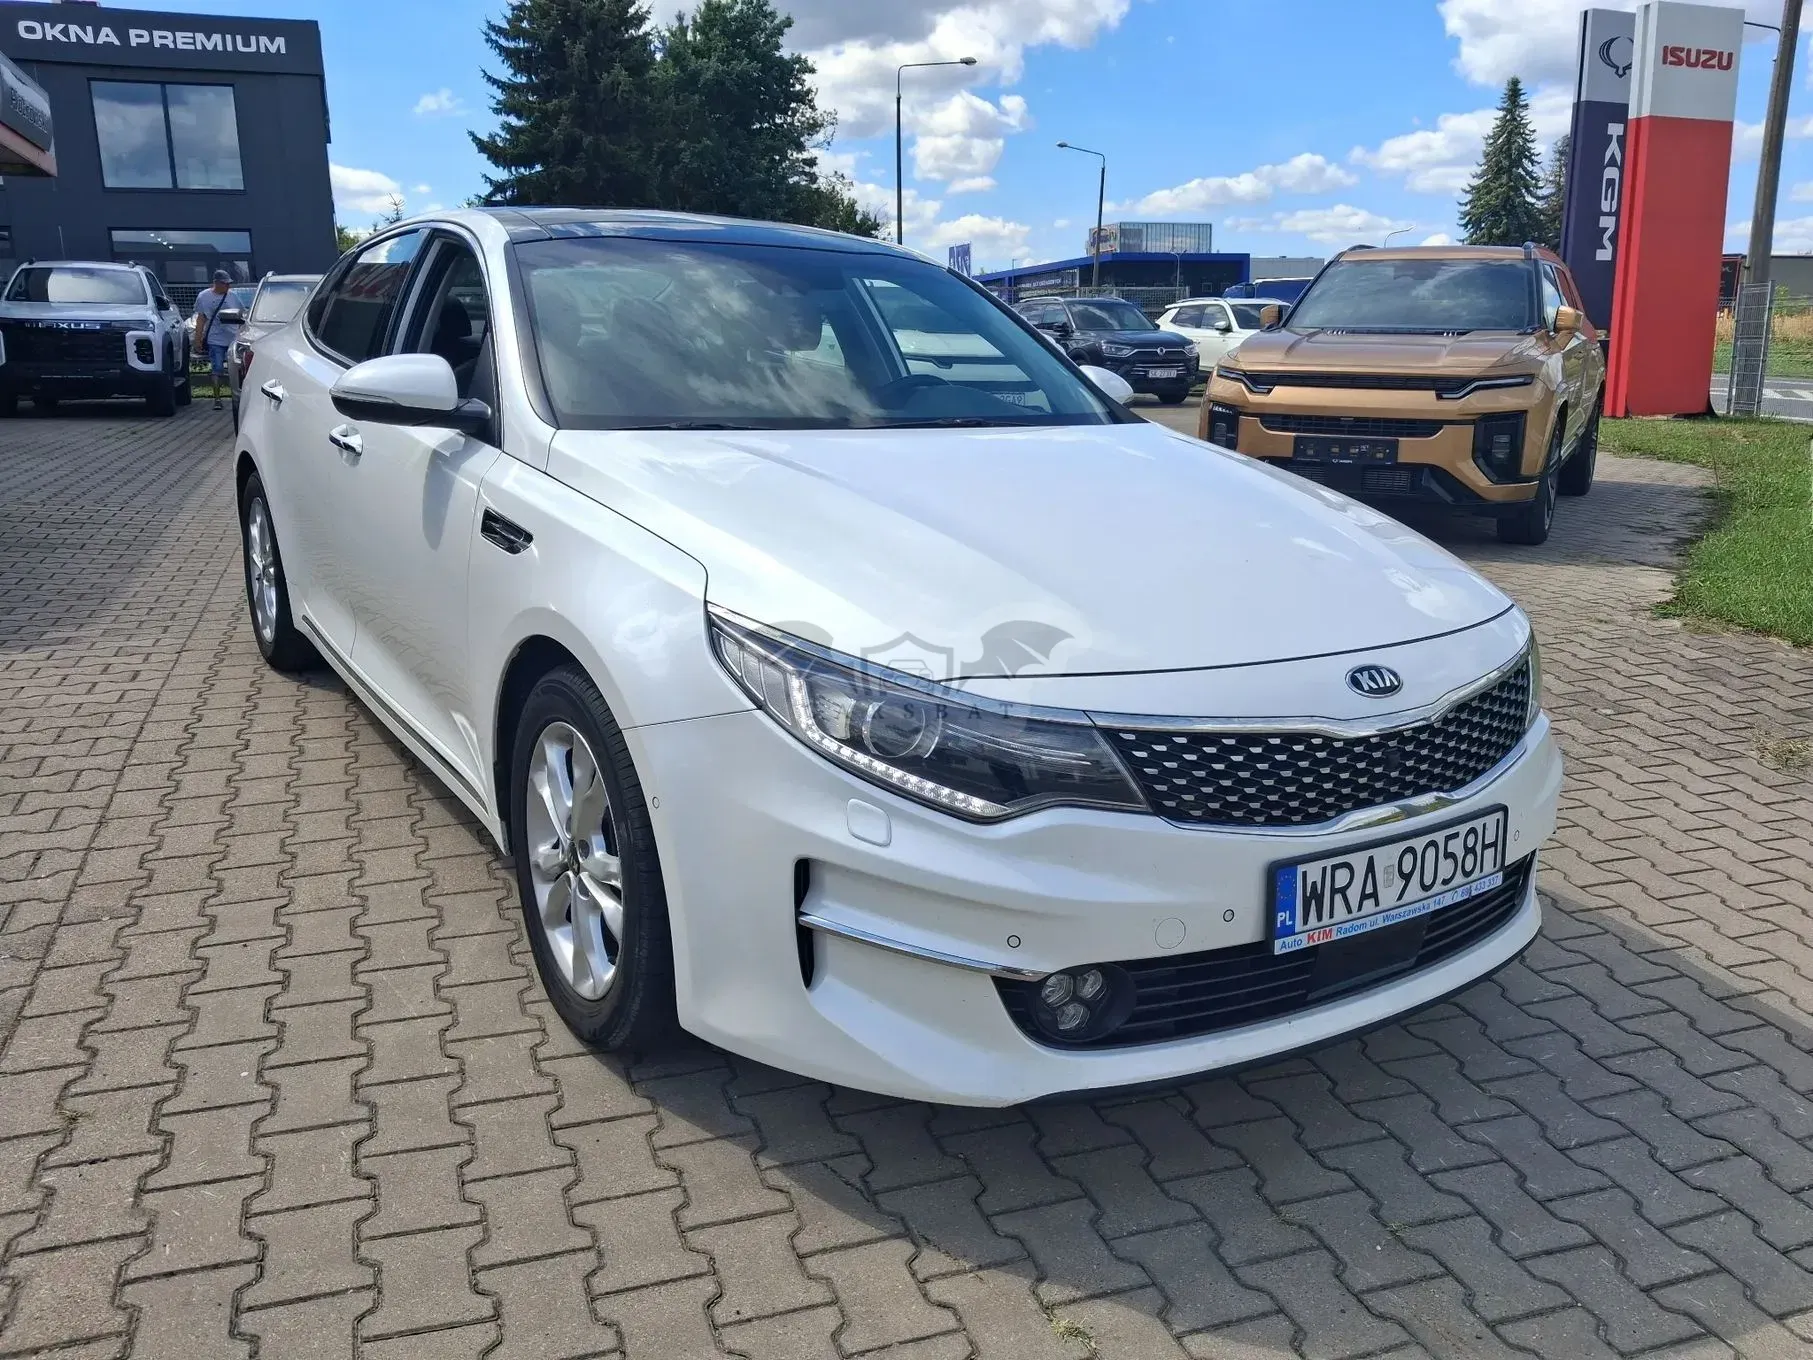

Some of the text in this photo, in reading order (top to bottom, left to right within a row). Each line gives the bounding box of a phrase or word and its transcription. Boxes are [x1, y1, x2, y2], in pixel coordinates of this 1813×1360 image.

[17, 20, 287, 54] OKNA PREMIUM
[1662, 45, 1734, 71] ISUZU
[1595, 122, 1625, 262] KGM
[1353, 667, 1399, 691] KIA
[1301, 818, 1500, 927] WRA 9058H
[1276, 911, 1293, 928] PL
[1280, 937, 1303, 951] Auto
[1306, 928, 1333, 944] KIM
[1336, 919, 1368, 937] Radom
[1369, 916, 1379, 928] ul.
[1382, 903, 1432, 927] Warszawska
